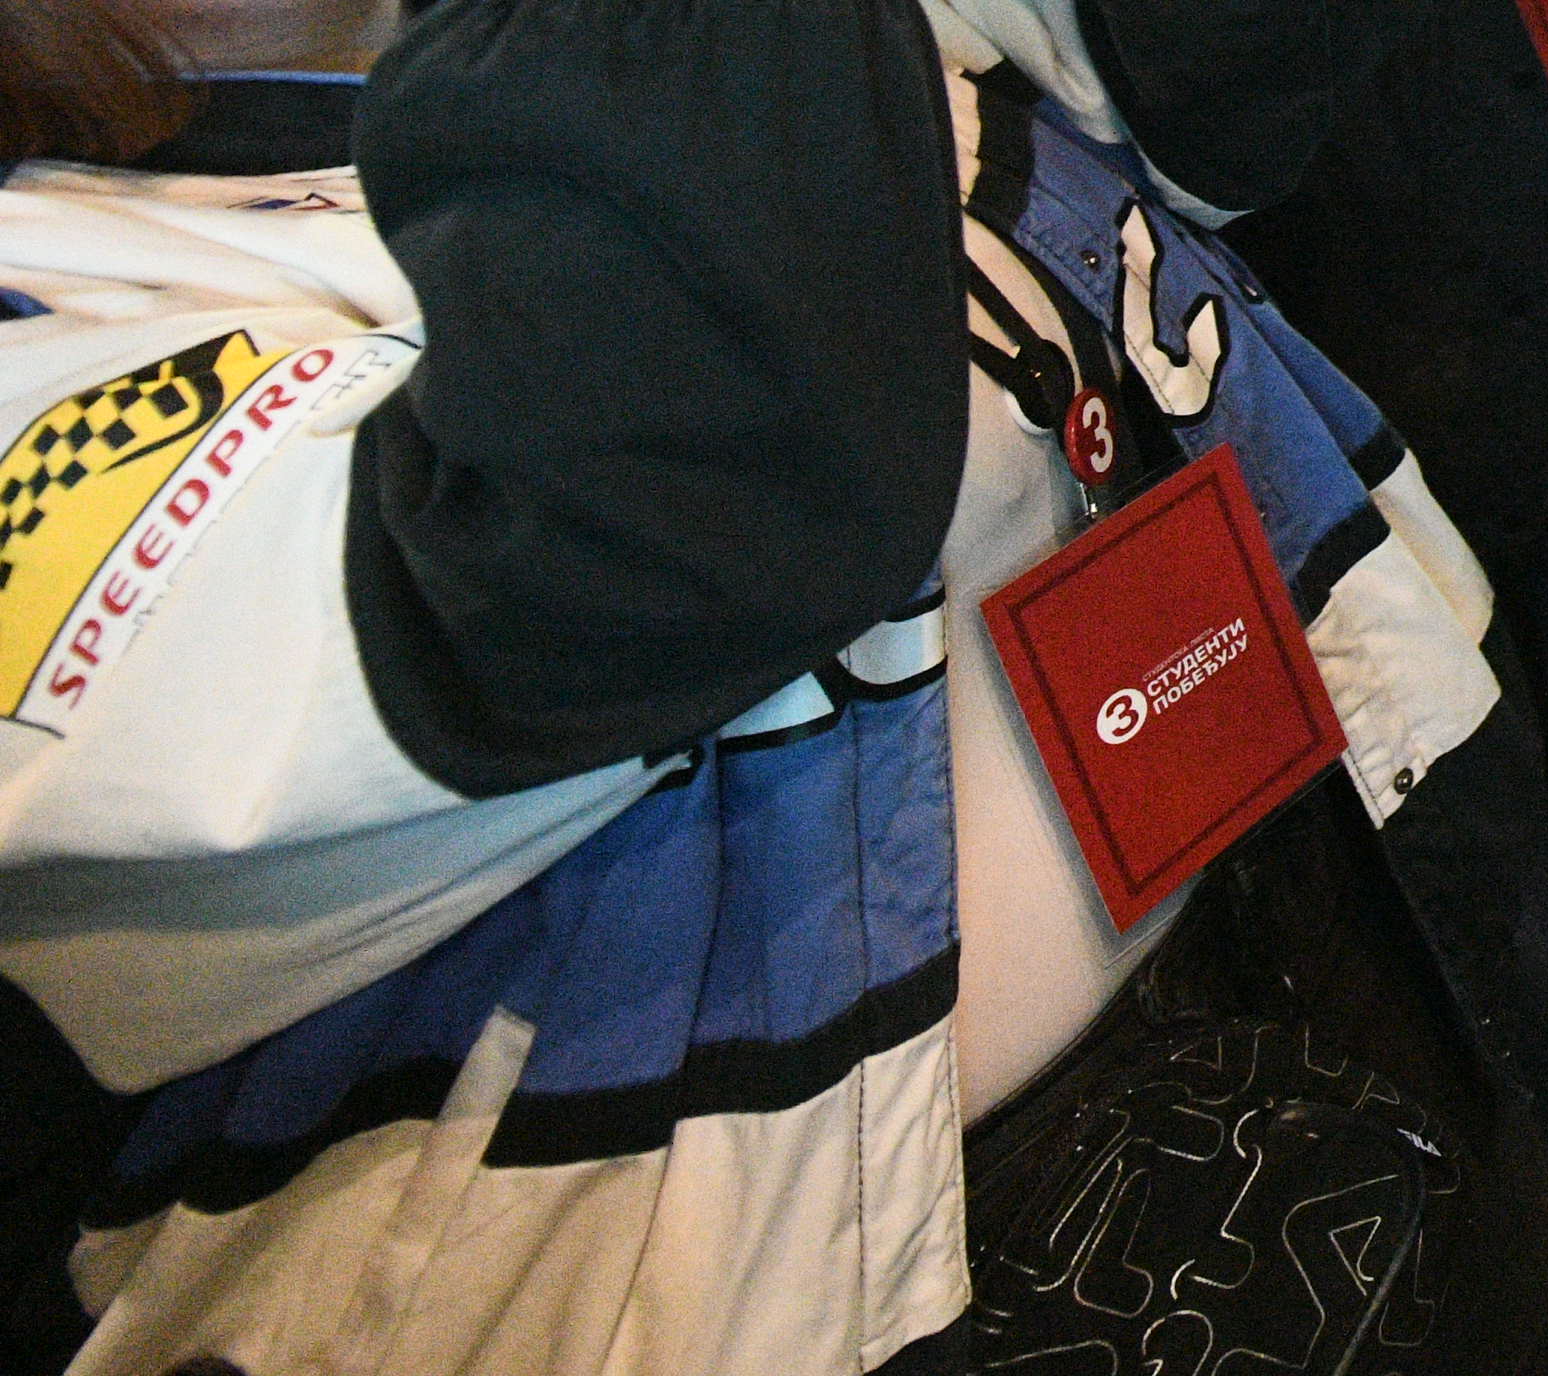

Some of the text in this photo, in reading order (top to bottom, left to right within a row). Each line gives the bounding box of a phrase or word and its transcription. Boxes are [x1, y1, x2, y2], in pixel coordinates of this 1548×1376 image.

[1082, 397, 1113, 473] 3
[48, 348, 335, 710] SPEEDPRO
[1147, 617, 1246, 697] СТУДЕНТИ
[1153, 634, 1249, 715] ПОБЕЂУЈУ
[1106, 694, 1139, 737] 3
